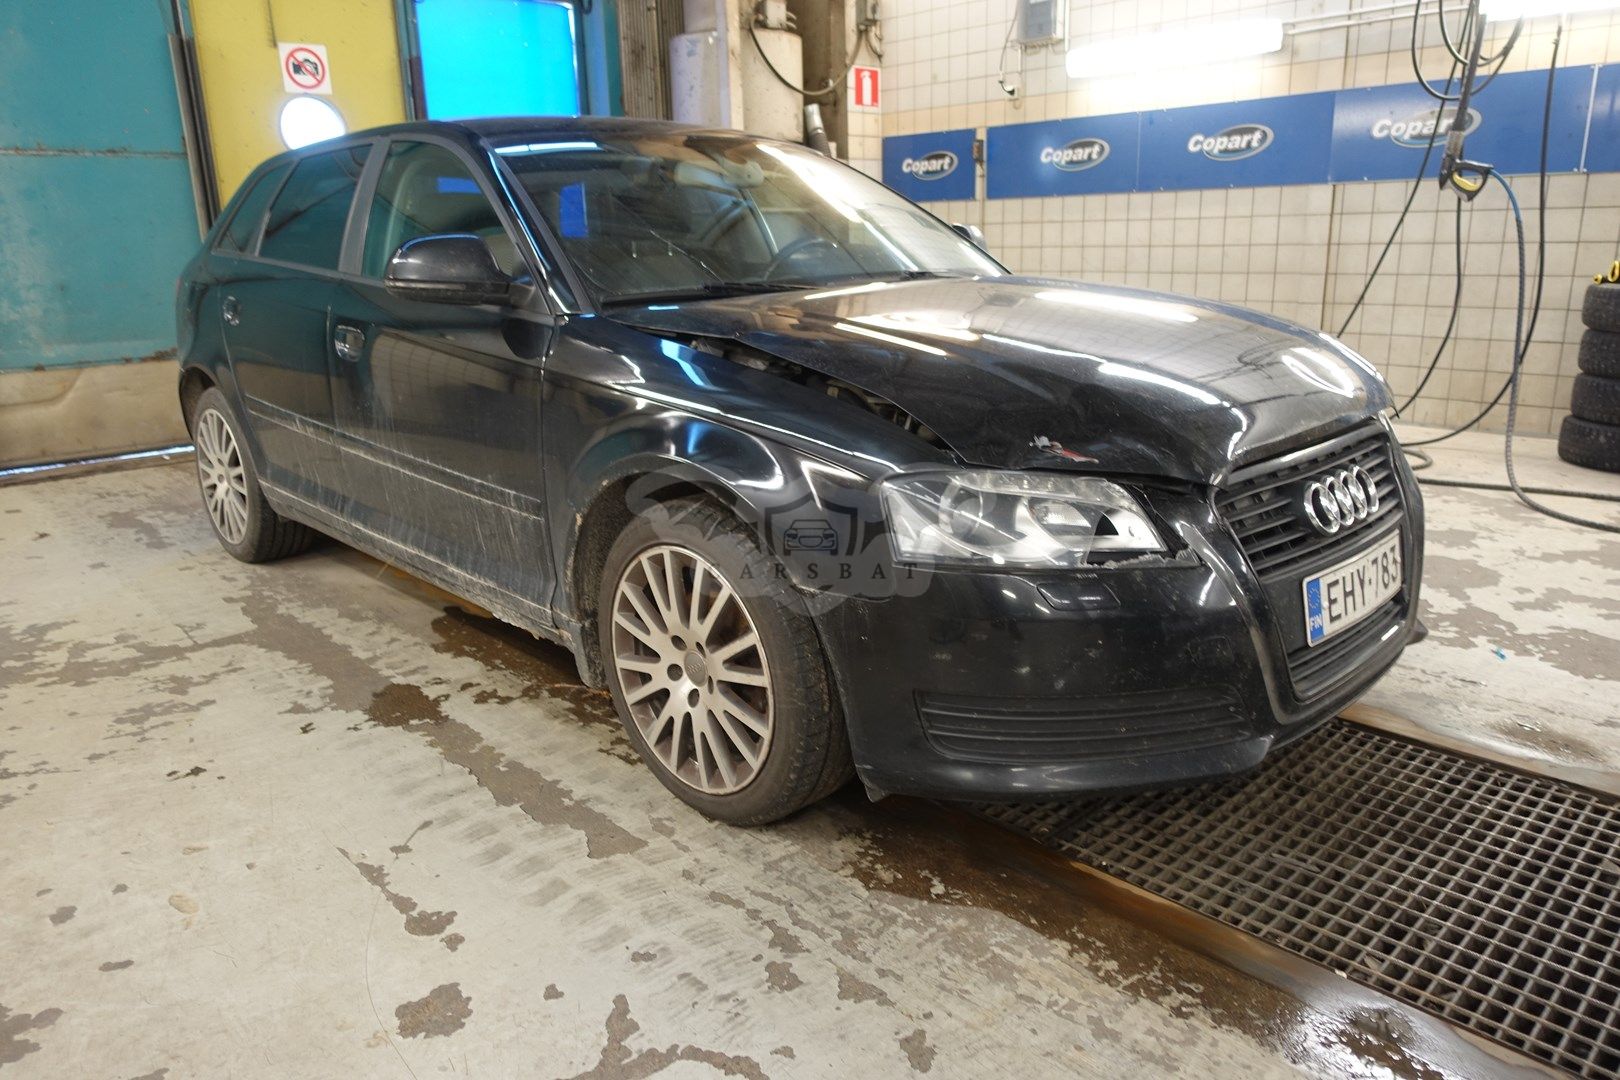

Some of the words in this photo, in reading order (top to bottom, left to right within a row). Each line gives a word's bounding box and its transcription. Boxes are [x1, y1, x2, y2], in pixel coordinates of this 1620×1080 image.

[1371, 117, 1454, 141] Copar
[1187, 130, 1264, 154] Copart
[1040, 143, 1101, 165] Copart
[902, 156, 951, 175] Copart
[1309, 612, 1323, 632] FIN
